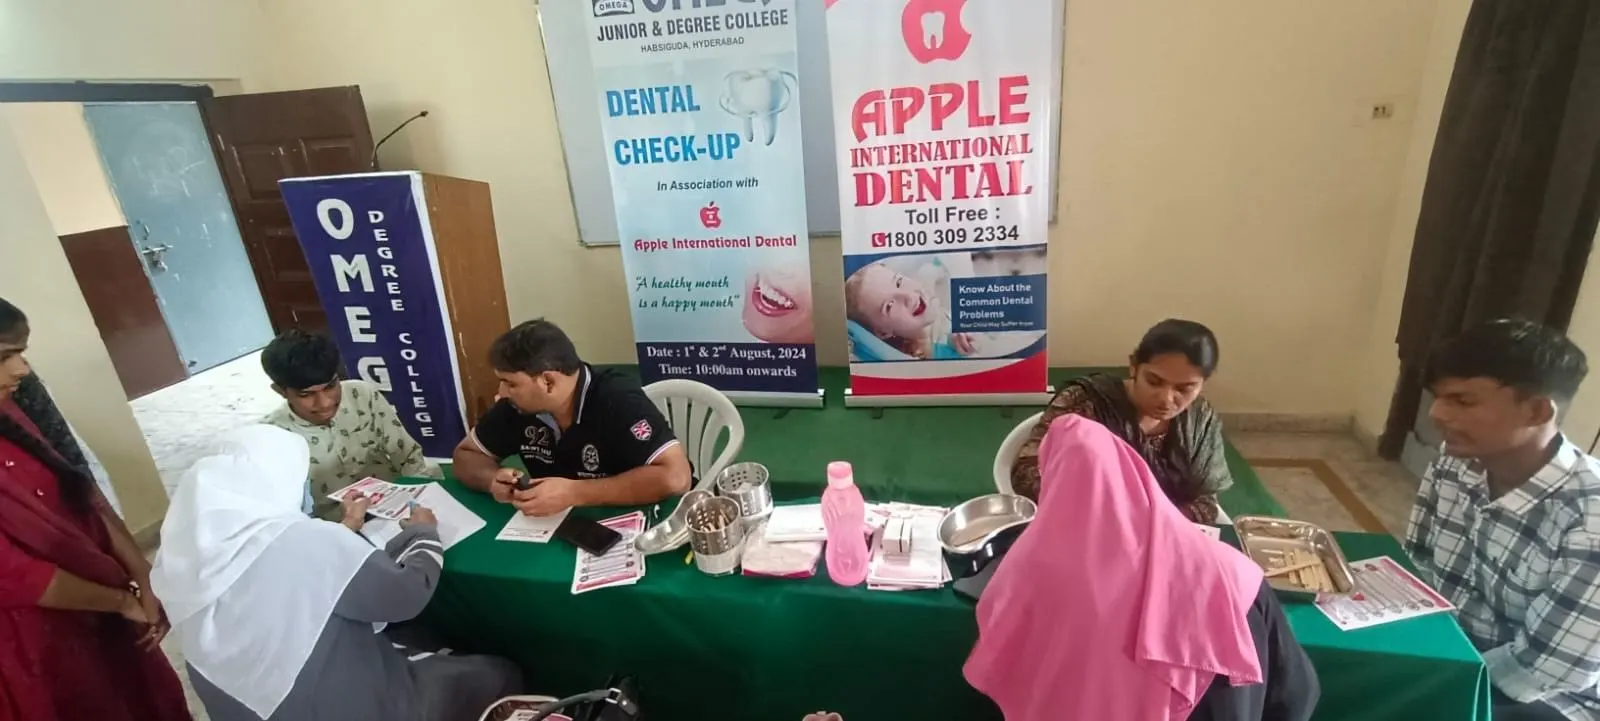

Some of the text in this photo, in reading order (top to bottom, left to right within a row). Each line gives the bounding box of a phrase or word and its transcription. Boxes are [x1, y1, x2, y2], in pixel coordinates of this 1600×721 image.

[599, 1, 628, 11] OMEGA
[597, 9, 788, 42] JUNIOR & DEGREE COLLEGE
[641, 36, 745, 53] HABSIGUDA, HYDERABAD
[606, 84, 701, 118] DENTAL
[851, 75, 1030, 143] APPLE
[614, 132, 741, 166] CHECK-UP
[849, 133, 1033, 168] INTERNATIONAL
[657, 177, 759, 191] In Association with
[853, 160, 1033, 207] DENTAL
[905, 206, 1001, 225] Toll Free :
[634, 234, 798, 252] Apple International Dental
[885, 225, 1020, 248] 1800 309 2334
[367, 210, 405, 312] DEGREE
[651, 277, 692, 291] healthy
[695, 276, 729, 289] mouth
[959, 283, 1032, 294] Know About the
[315, 198, 396, 412] OMEG
[638, 298, 648, 309] is
[661, 297, 696, 312] happy
[960, 295, 1033, 307] Common Dental
[960, 309, 1005, 319] Problems
[647, 346, 675, 357] Date
[684, 346, 695, 358] 1st
[698, 348, 709, 358] &
[712, 345, 726, 358] 2nd
[729, 347, 776, 361] August,
[778, 347, 807, 360] 2024
[658, 363, 797, 377] Time: 10:00am onwards
[398, 332, 435, 437] COLLEGE
[524, 425, 549, 446] 92
